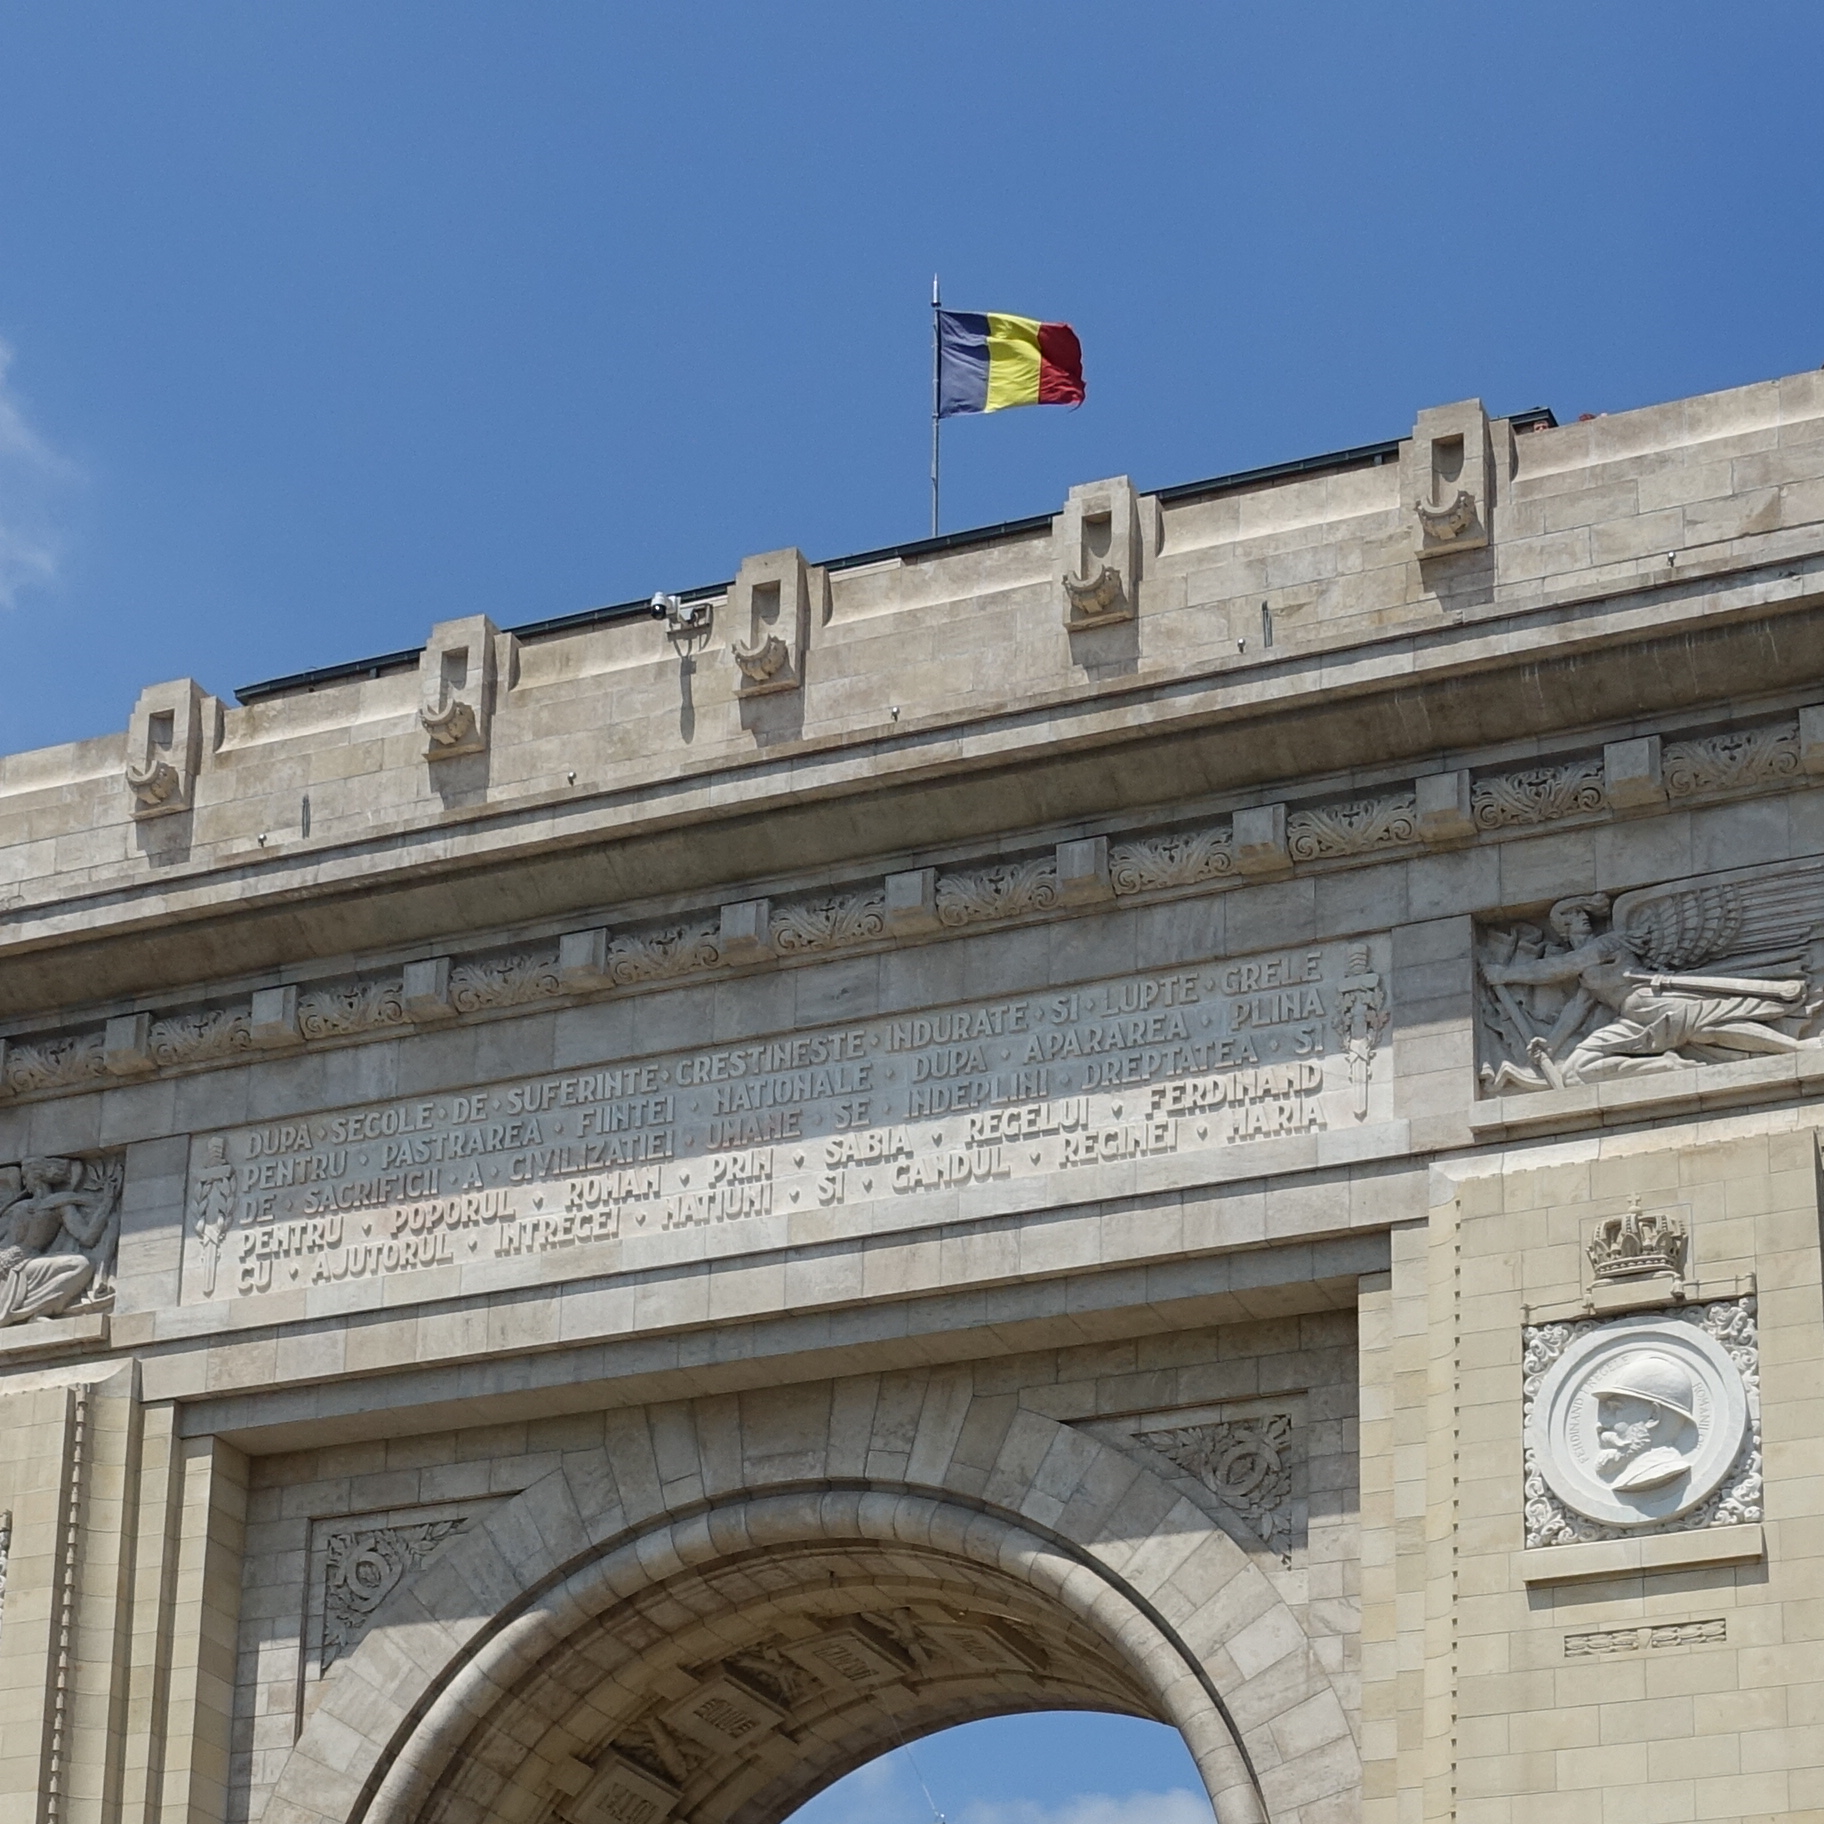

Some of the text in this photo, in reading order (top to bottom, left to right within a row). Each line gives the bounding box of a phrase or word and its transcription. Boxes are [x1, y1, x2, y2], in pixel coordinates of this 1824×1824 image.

[239, 1022, 1325, 1226] DE SACRIFICII A CIVILIZATIEI UMANE SE INDEPLINI DREPTATEA SI
[242, 987, 1327, 1194] PENTRU PASTRAREA FIINTEI NATIONALE DUPA APARAREA PLINA
[245, 951, 1324, 1161] DUPA SECOLE DE SUFERINTE CRESTINESTE INDURATE SI LUPTE GRELE
[238, 1259, 274, 1296] CU
[312, 1232, 454, 1287] AJUTORUL
[661, 1181, 774, 1232] NATIUNI
[817, 1171, 845, 1207] SI
[891, 1146, 1011, 1193] GANDUL
[1059, 1119, 1178, 1170] REGINEI
[1226, 1096, 1328, 1144] MARIA
[239, 1061, 1324, 1264] PENTRU POPORUL ROMAN PRIN SABIA REGELUI FERDINAND
